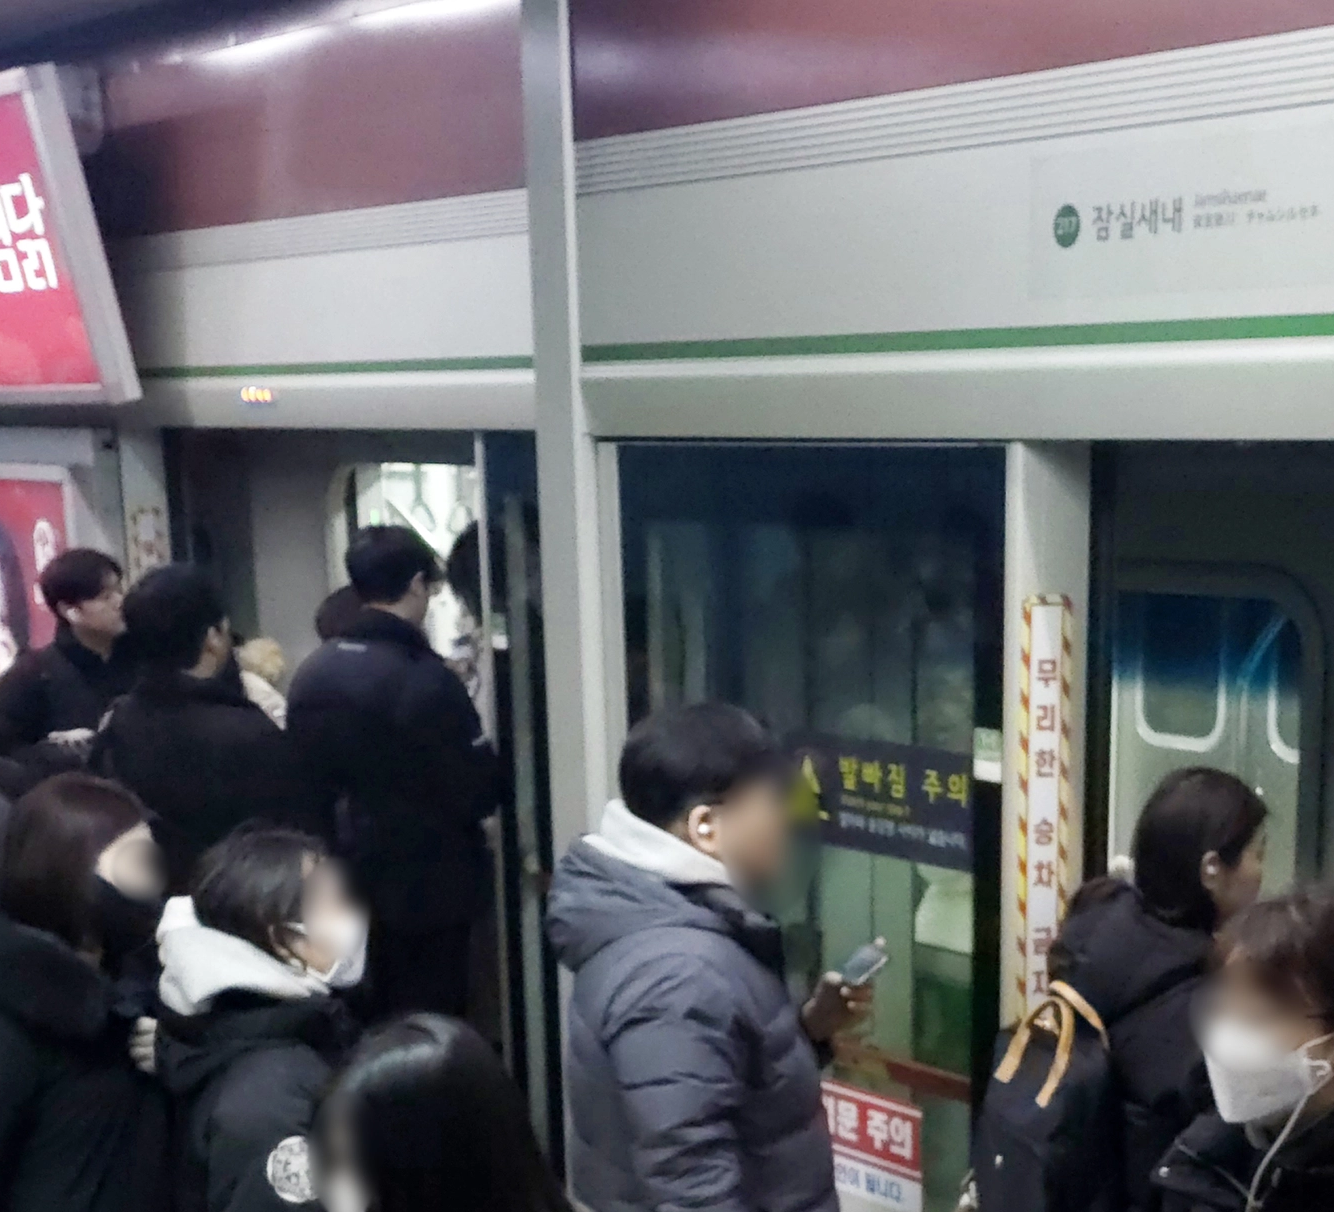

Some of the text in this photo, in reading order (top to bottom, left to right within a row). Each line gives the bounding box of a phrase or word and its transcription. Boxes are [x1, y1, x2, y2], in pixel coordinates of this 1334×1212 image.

[1092, 196, 1185, 241] 잠실새내
[1035, 658, 1057, 778] 무리한
[921, 768, 968, 809] 주의
[1033, 816, 1054, 887] 승차
[866, 1107, 914, 1161] 주의
